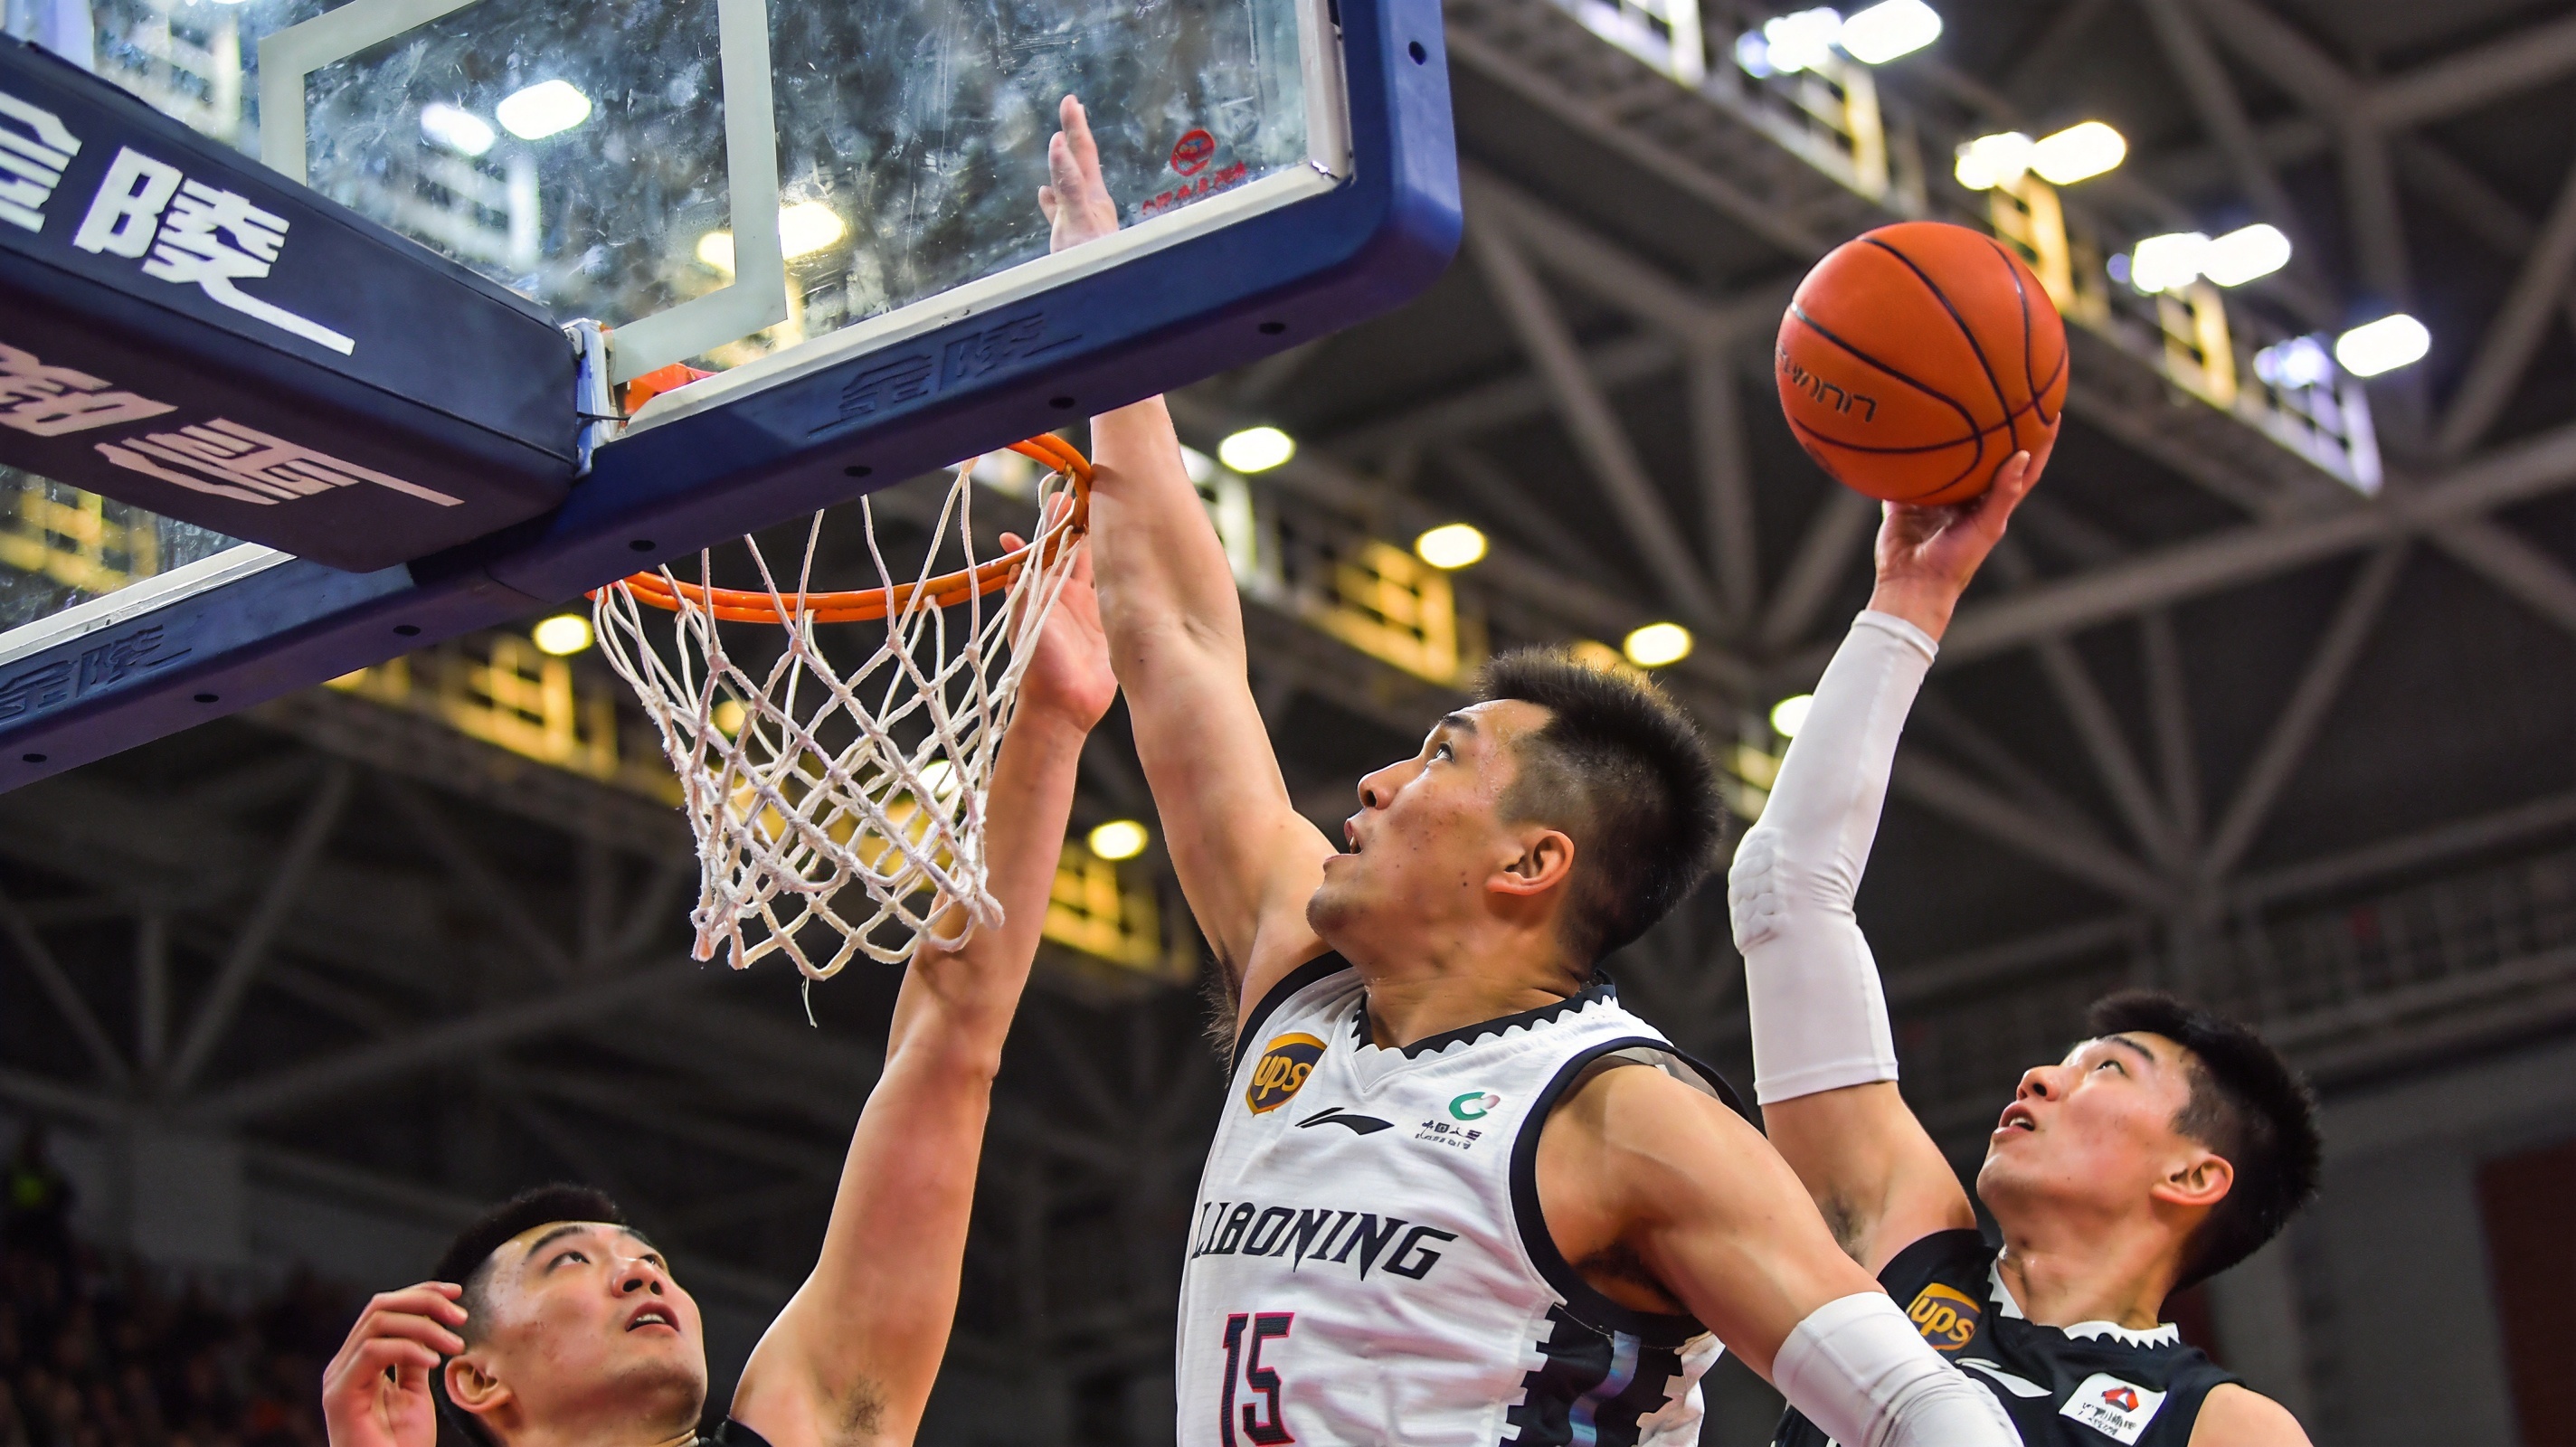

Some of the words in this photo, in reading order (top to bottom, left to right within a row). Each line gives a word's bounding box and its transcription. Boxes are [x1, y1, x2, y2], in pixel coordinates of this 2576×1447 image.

[1254, 1055, 1313, 1101] ups
[1191, 1201, 1459, 1282] LIAONING
[1915, 1297, 1975, 1343] ups
[1219, 1311, 1296, 1447] 15
